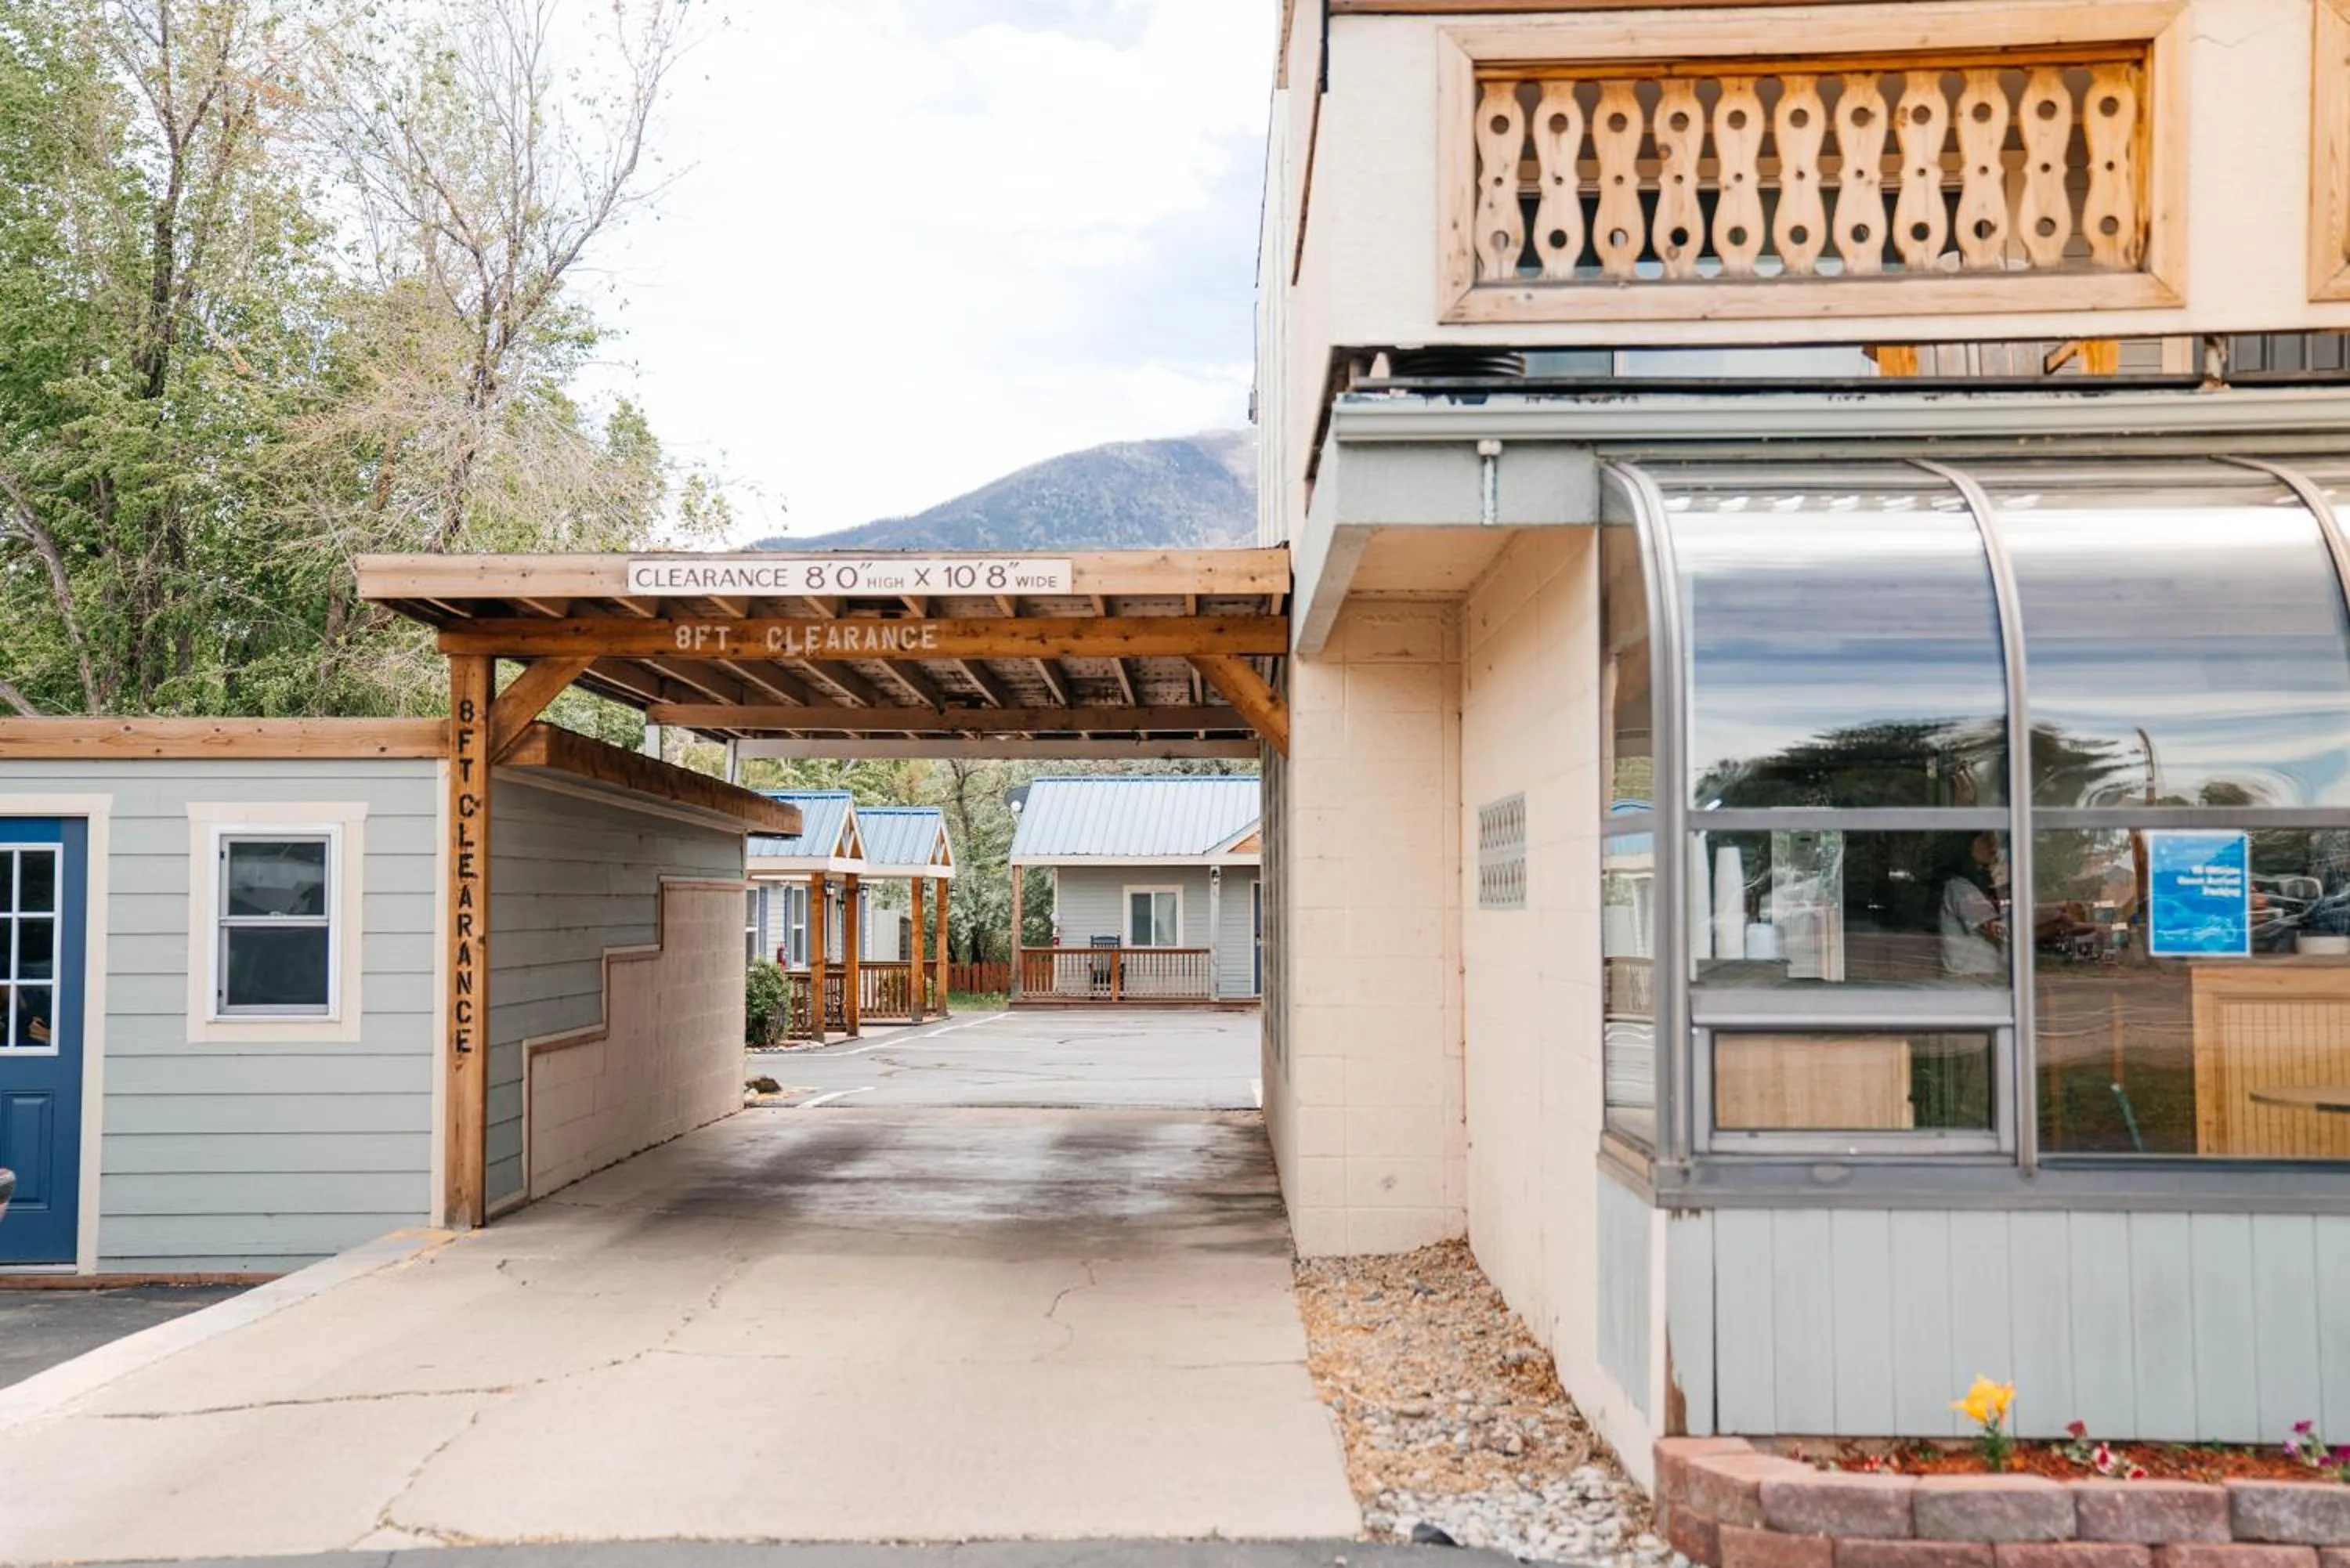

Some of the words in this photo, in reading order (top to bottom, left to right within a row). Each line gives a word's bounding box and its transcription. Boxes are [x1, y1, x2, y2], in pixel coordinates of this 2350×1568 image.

[635, 568, 788, 587] CLEARANCE
[866, 576, 904, 588] HIGH
[914, 568, 931, 587] X
[1014, 576, 1058, 587] WIDE
[674, 625, 731, 651] 8FT
[765, 625, 938, 656] CLEARANCE
[457, 699, 475, 783] 8FT
[457, 793, 476, 1053] CLEARANCE
